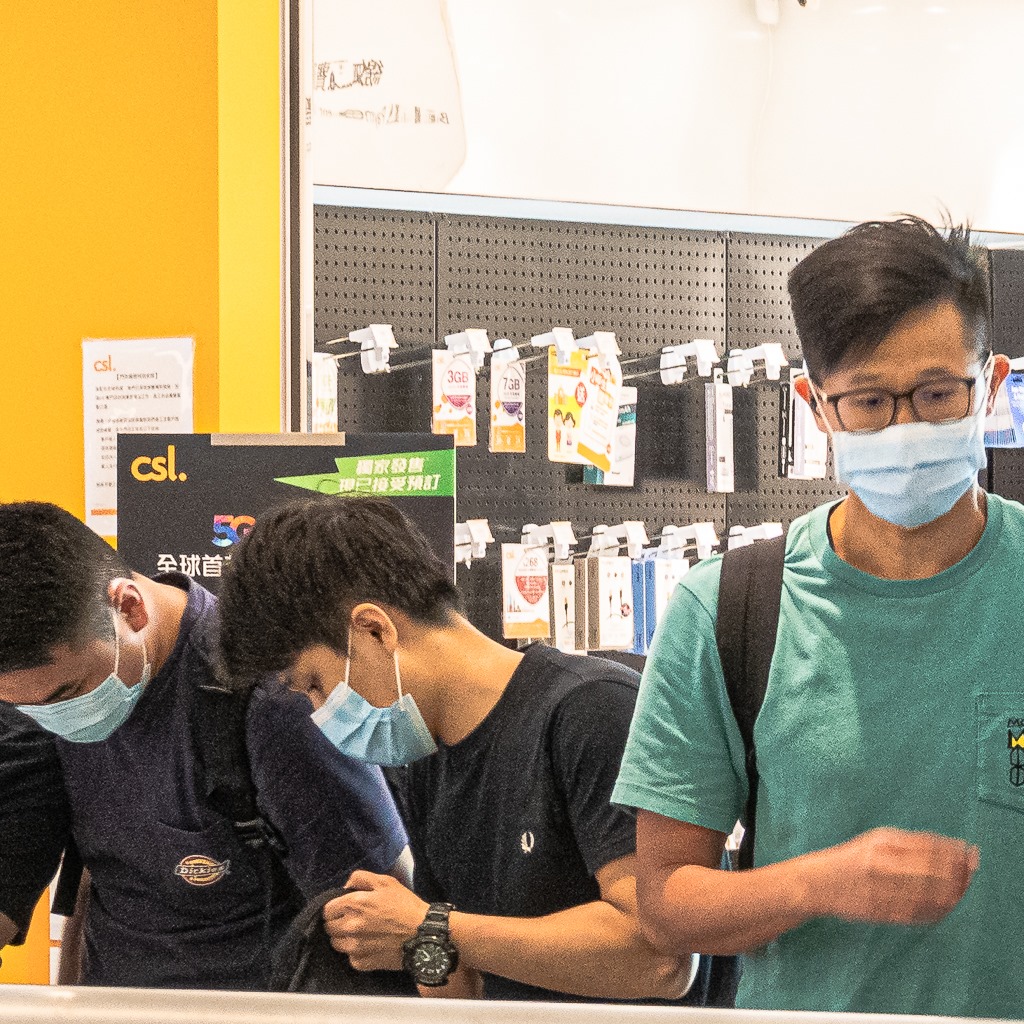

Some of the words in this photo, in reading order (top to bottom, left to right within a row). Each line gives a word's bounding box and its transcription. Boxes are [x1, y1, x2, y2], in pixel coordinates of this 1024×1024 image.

[447, 369, 469, 384] 3GB
[503, 377, 521, 390] 7GB
[130, 444, 188, 482] csl.
[157, 553, 231, 577] 全球首
